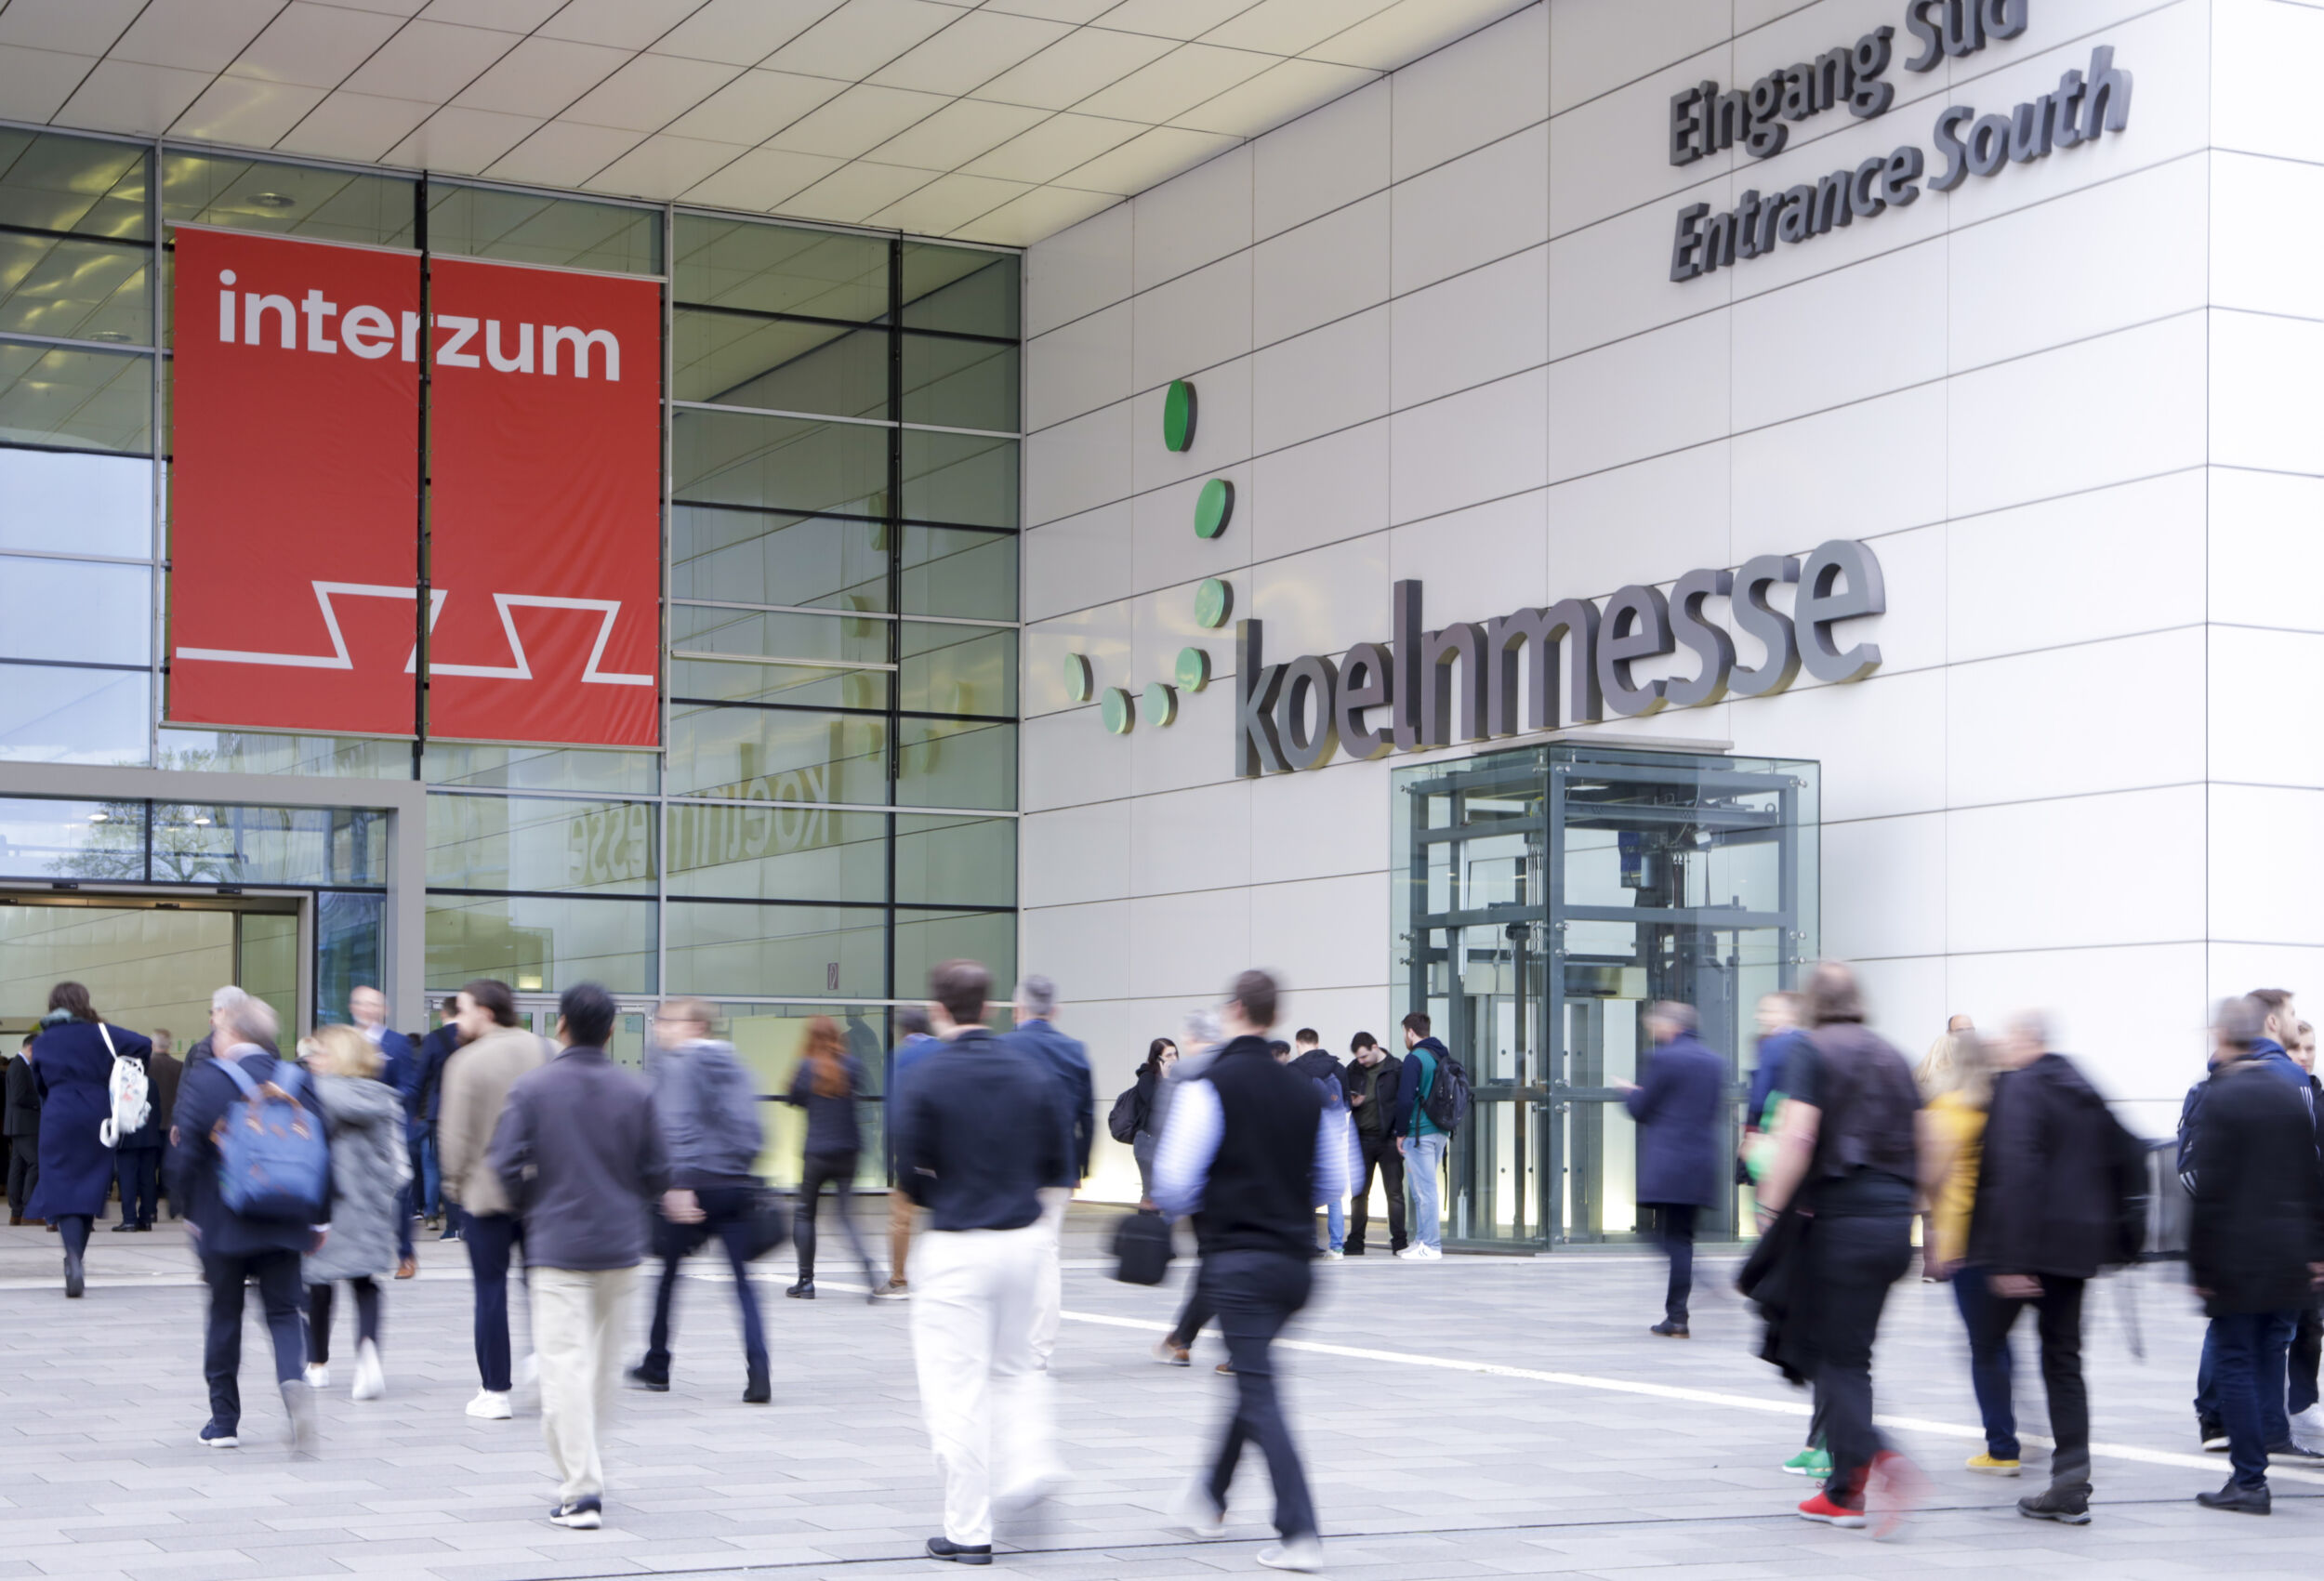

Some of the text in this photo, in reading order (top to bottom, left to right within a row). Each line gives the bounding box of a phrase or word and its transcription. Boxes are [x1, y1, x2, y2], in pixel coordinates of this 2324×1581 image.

[1670, 26, 1895, 165] Eingang
[1670, 45, 2133, 282] Entrance South
[219, 269, 620, 381] interzum
[1235, 539, 1885, 778] koelnmesse
